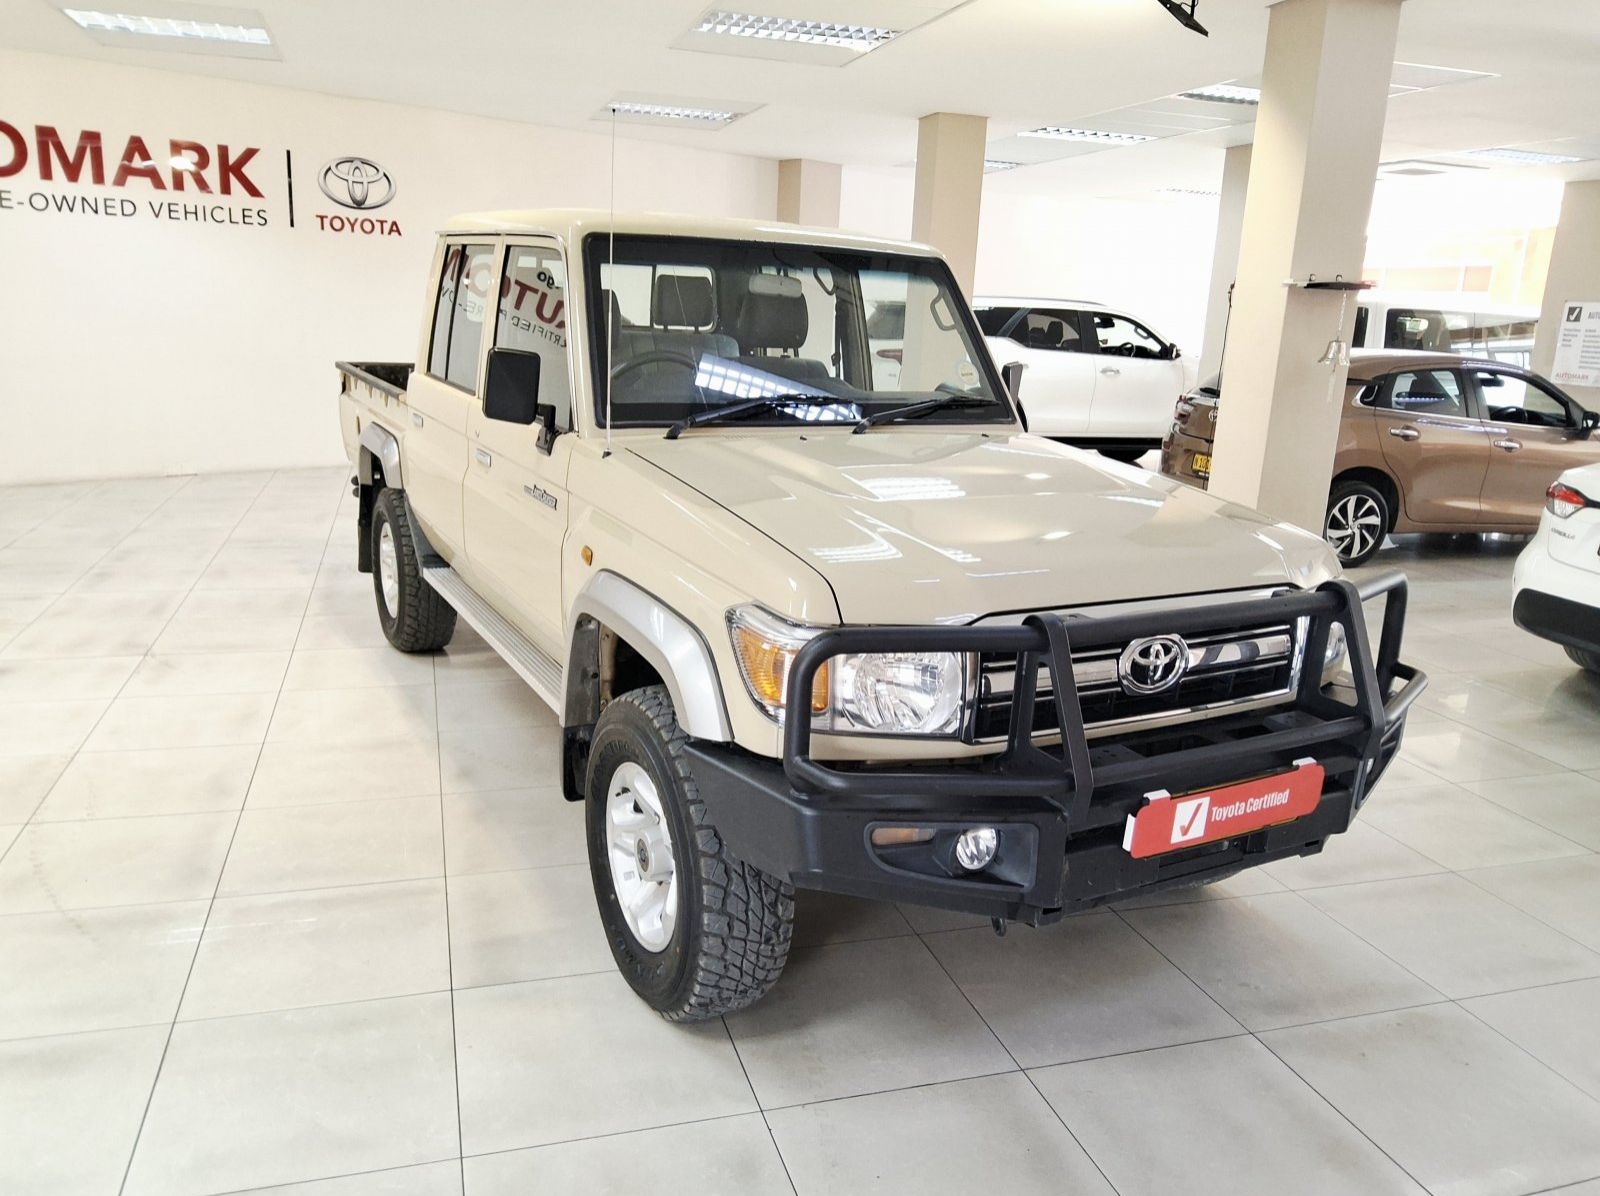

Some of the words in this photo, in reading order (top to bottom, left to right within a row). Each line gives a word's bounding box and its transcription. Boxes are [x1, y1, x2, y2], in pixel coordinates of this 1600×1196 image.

[149, 201, 268, 227] VEHICLES
[315, 214, 402, 237] TOYOTA
[1211, 802, 1246, 822] Toyota
[1246, 788, 1290, 813] Certified
